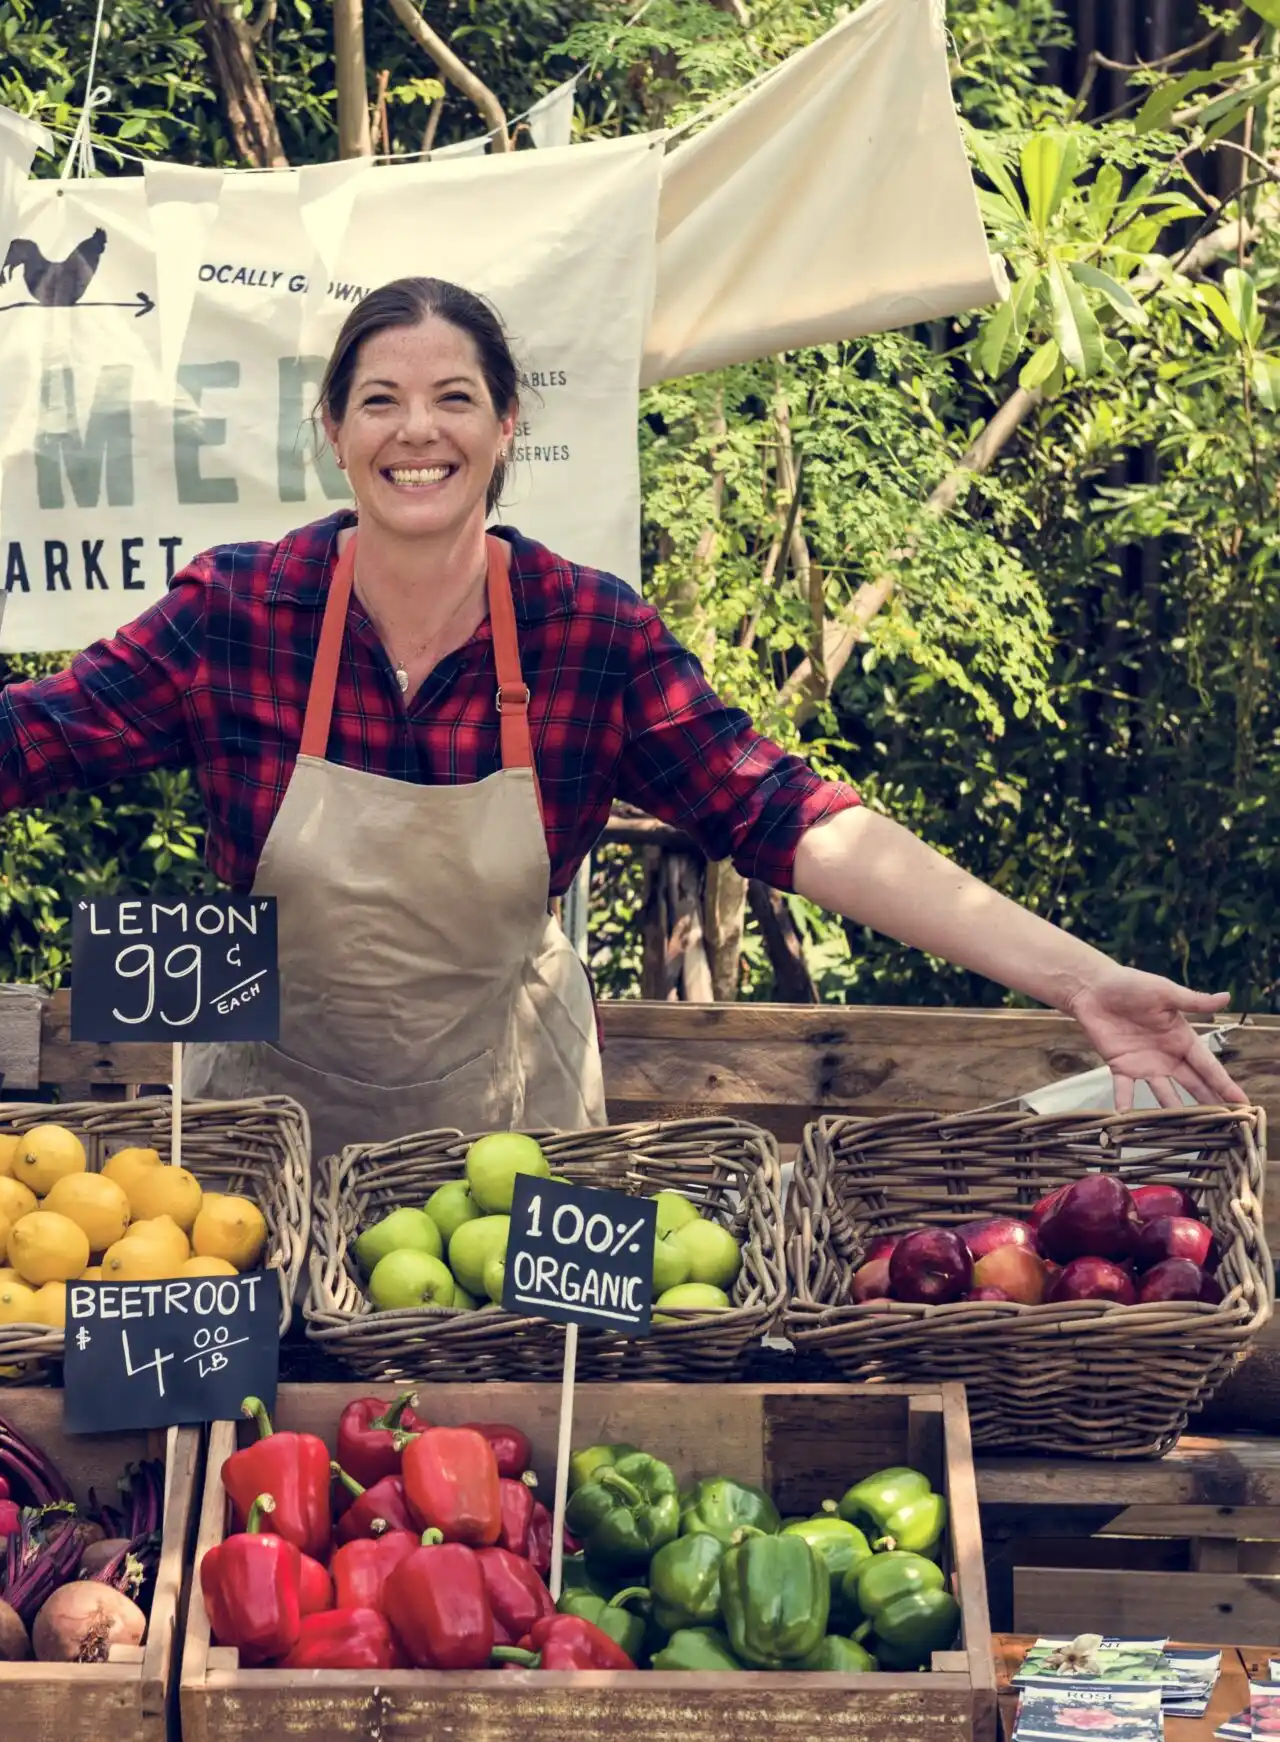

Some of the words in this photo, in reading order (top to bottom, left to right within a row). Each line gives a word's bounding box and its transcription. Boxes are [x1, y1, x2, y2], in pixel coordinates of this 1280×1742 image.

[198, 264, 282, 288] OCALLY
[519, 370, 567, 388] ABLES
[514, 421, 531, 437] SE
[516, 445, 570, 462] SERVES
[217, 983, 260, 1015] EACH
[526, 1195, 645, 1257] 100%
[514, 1251, 643, 1312] ORGANIC
[71, 1276, 261, 1320] BEETROOT
[193, 1326, 229, 1348] 00
[198, 1352, 229, 1378] LB
